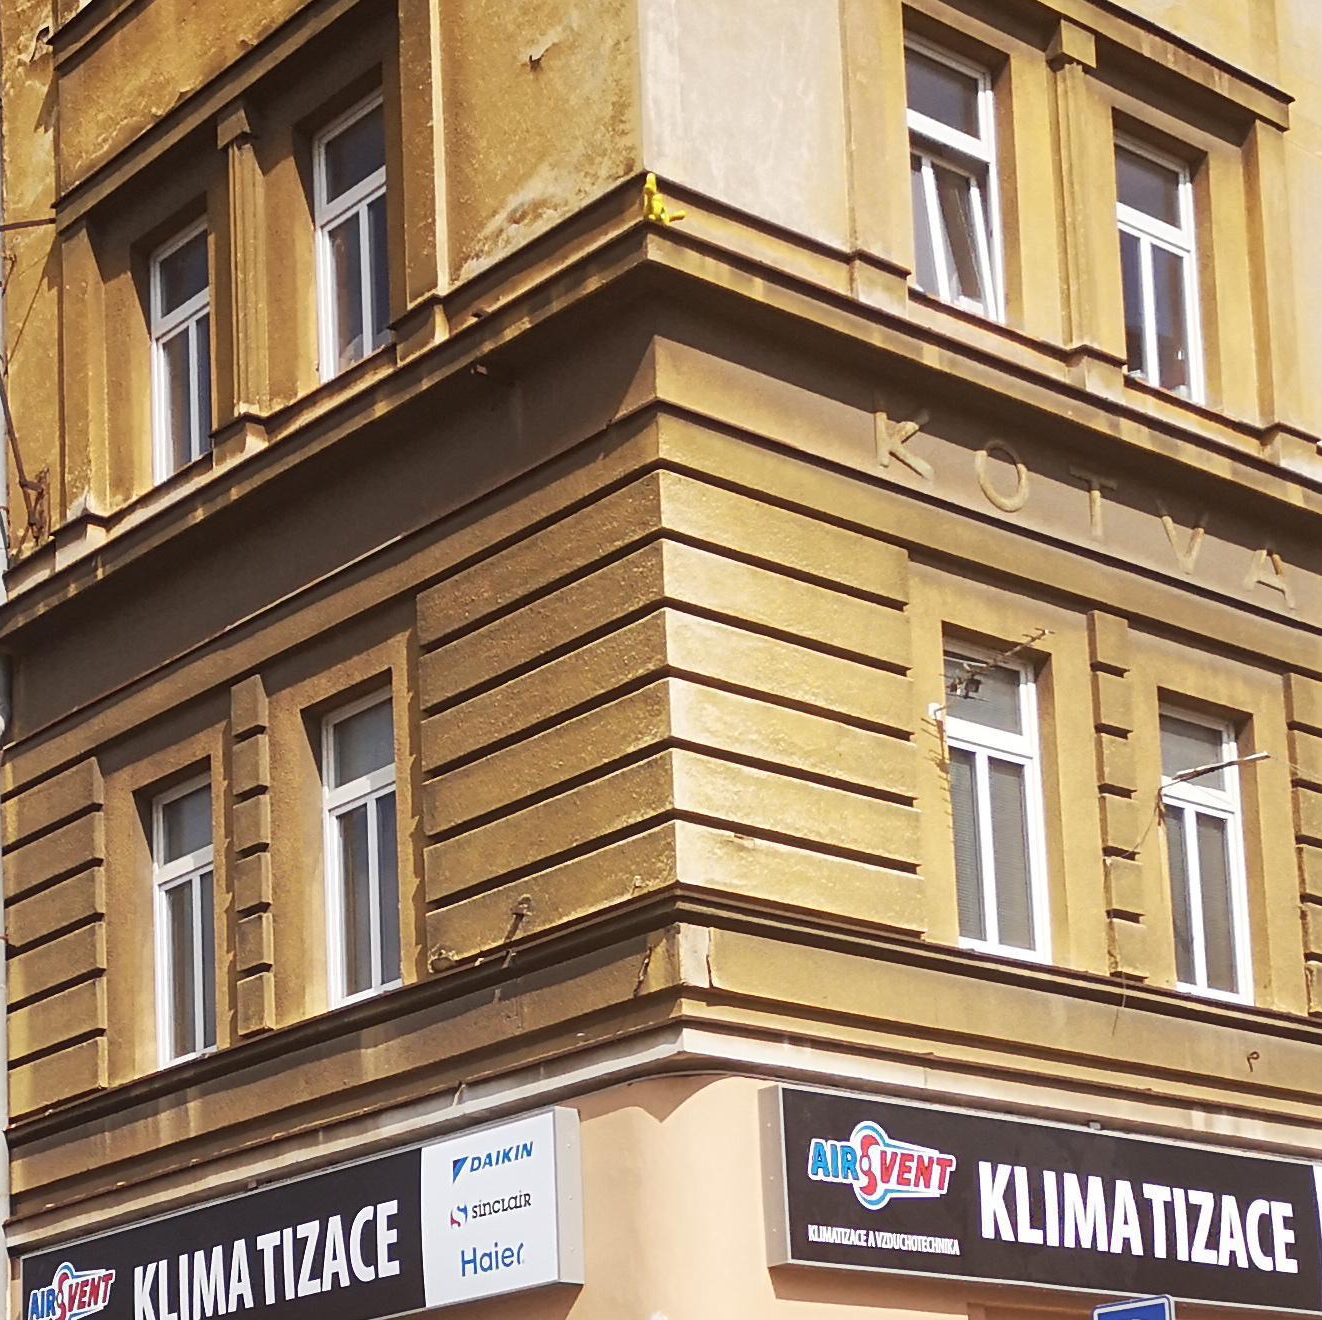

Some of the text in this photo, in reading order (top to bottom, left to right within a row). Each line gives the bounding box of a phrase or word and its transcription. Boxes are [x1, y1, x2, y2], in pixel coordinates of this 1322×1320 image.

[469, 1141, 534, 1173] DAIKIN
[978, 1160, 1299, 1274] KLIMATIZACE
[807, 1223, 961, 1257] KLIMATIZACE A VZDUCHOTECHNIKA
[460, 1241, 525, 1277] Haier
